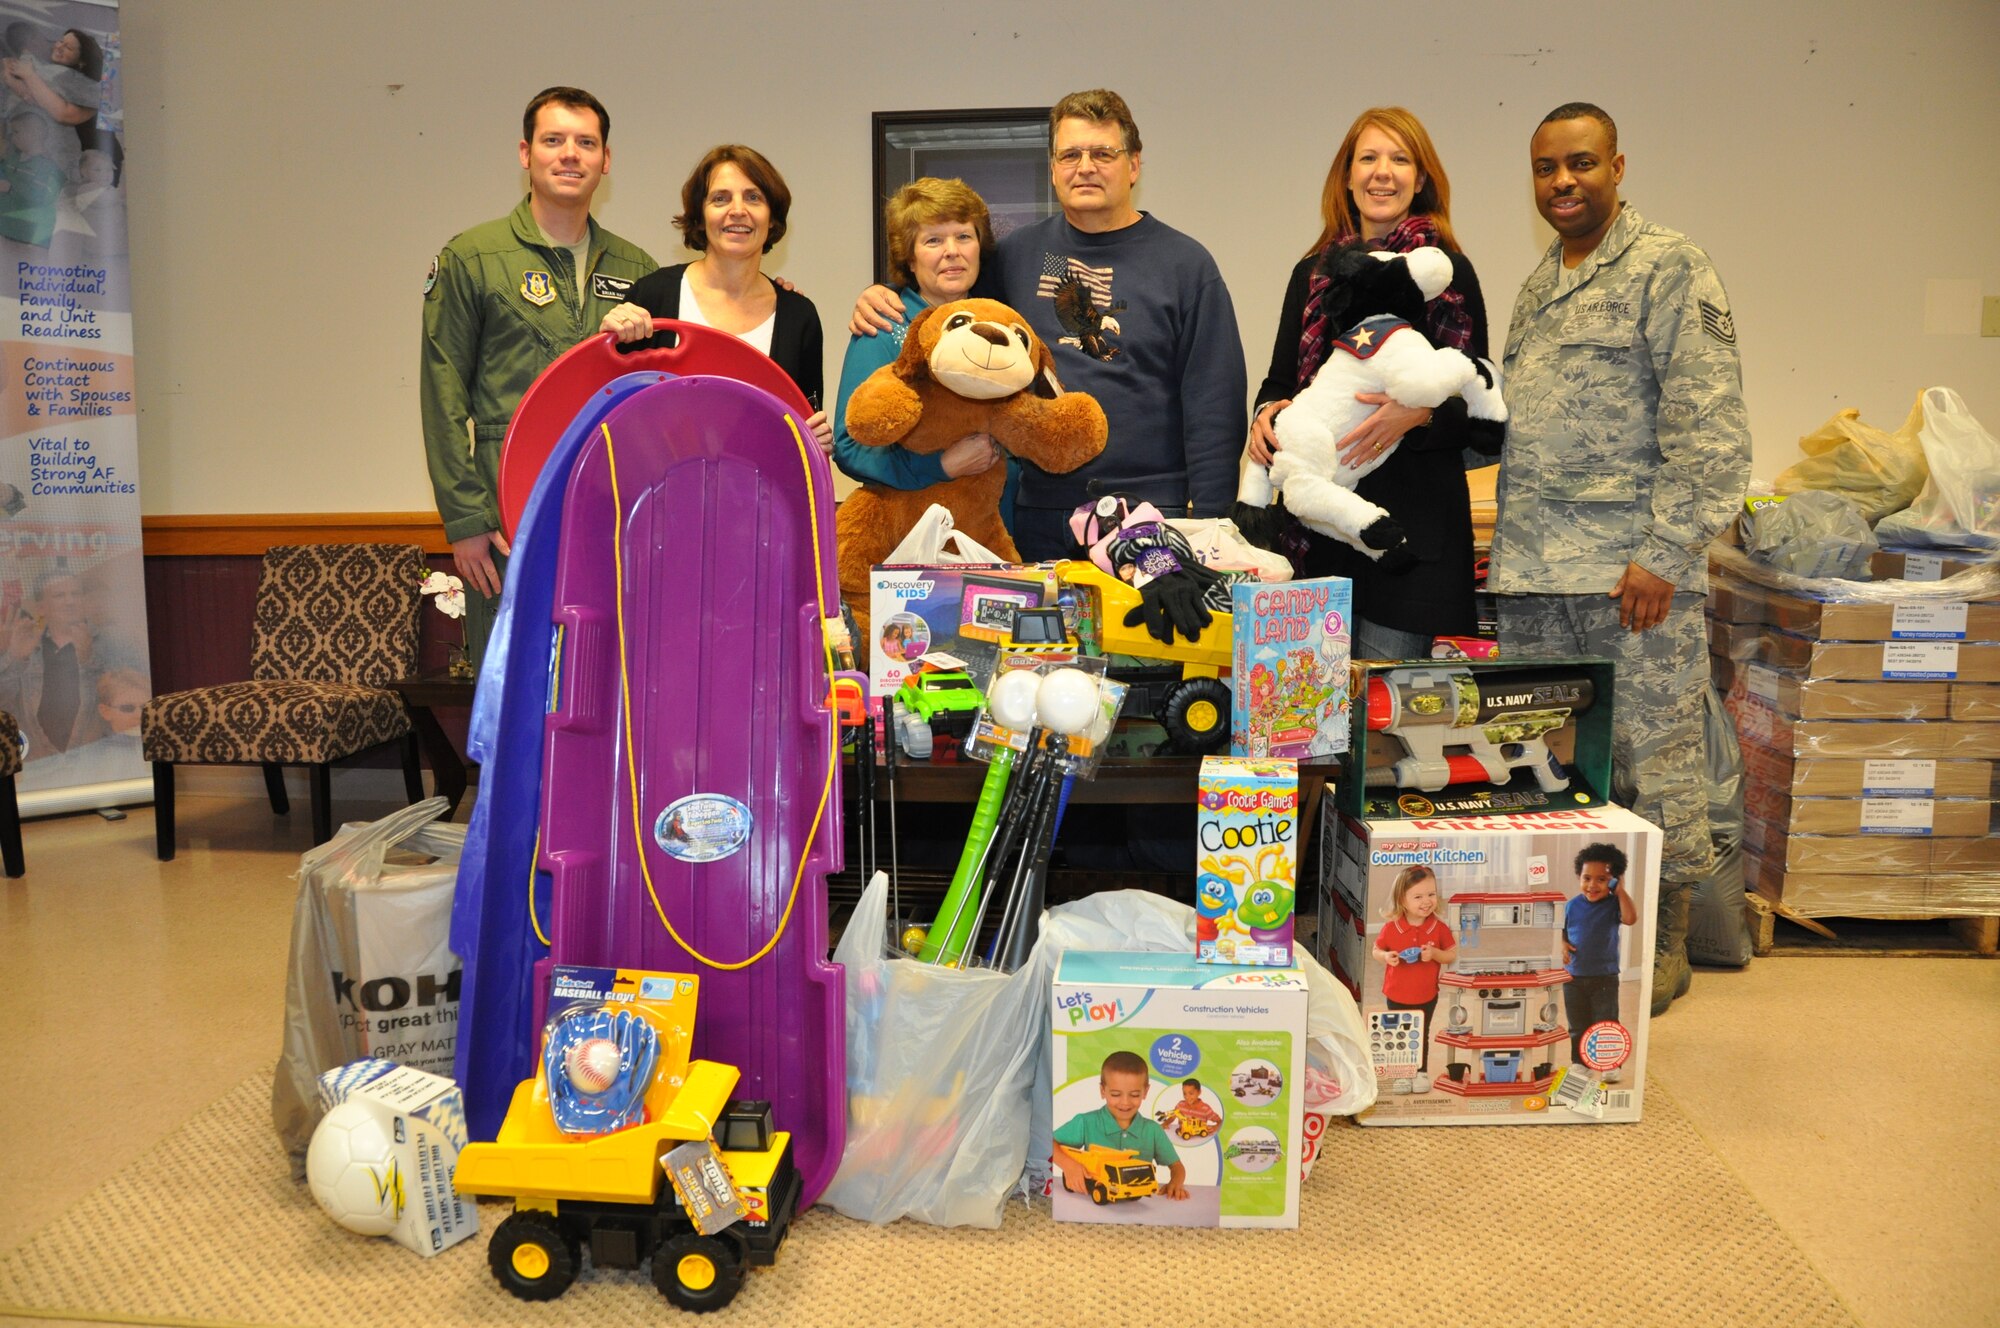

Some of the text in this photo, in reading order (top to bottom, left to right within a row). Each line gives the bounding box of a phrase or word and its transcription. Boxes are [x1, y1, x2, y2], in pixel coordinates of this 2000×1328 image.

[18, 262, 106, 282] Promoting
[18, 278, 106, 296] Individual,
[20, 293, 82, 310] Family,
[1600, 301, 1630, 314] FORCE
[21, 309, 96, 323] and Unit
[22, 324, 102, 339] Readiness
[24, 357, 114, 372] Continuous
[25, 372, 90, 387] Contact
[26, 388, 131, 405] with Spouses
[28, 404, 112, 417] & Families
[29, 438, 90, 451] Vital to
[31, 453, 96, 469] Building
[31, 468, 115, 484] Strong AF
[32, 481, 136, 496] Communities
[883, 580, 933, 591] Discovery
[896, 589, 927, 598] KIDS
[1255, 586, 1329, 617] CANDY
[1255, 615, 1310, 645] LAND
[887, 670, 900, 678] 60
[1487, 697, 1505, 708] U.S.
[1505, 694, 1533, 706] NAVY
[1228, 791, 1293, 809] Cootie Games
[1435, 801, 1458, 811] U.S.
[1458, 799, 1492, 810] NAVY
[1200, 813, 1292, 852] Cootie
[1410, 820, 1608, 831] Kitchen
[1381, 841, 1438, 850] my very own
[1372, 849, 1484, 864] Gourmet Kitchen
[553, 988, 637, 1004] BASEBALL GLOVE
[1057, 992, 1093, 1009] Let's
[1068, 998, 1125, 1027] play!
[1183, 1004, 1269, 1014] Construction Vehicles
[377, 1012, 431, 1033] great
[374, 1042, 417, 1059] GRAY
[1171, 1037, 1182, 1051] 2
[420, 1058, 435, 1066] you
[1158, 1048, 1193, 1061] Vehicles
[704, 1157, 730, 1203] Tonka
[684, 1169, 709, 1212] STEEL
